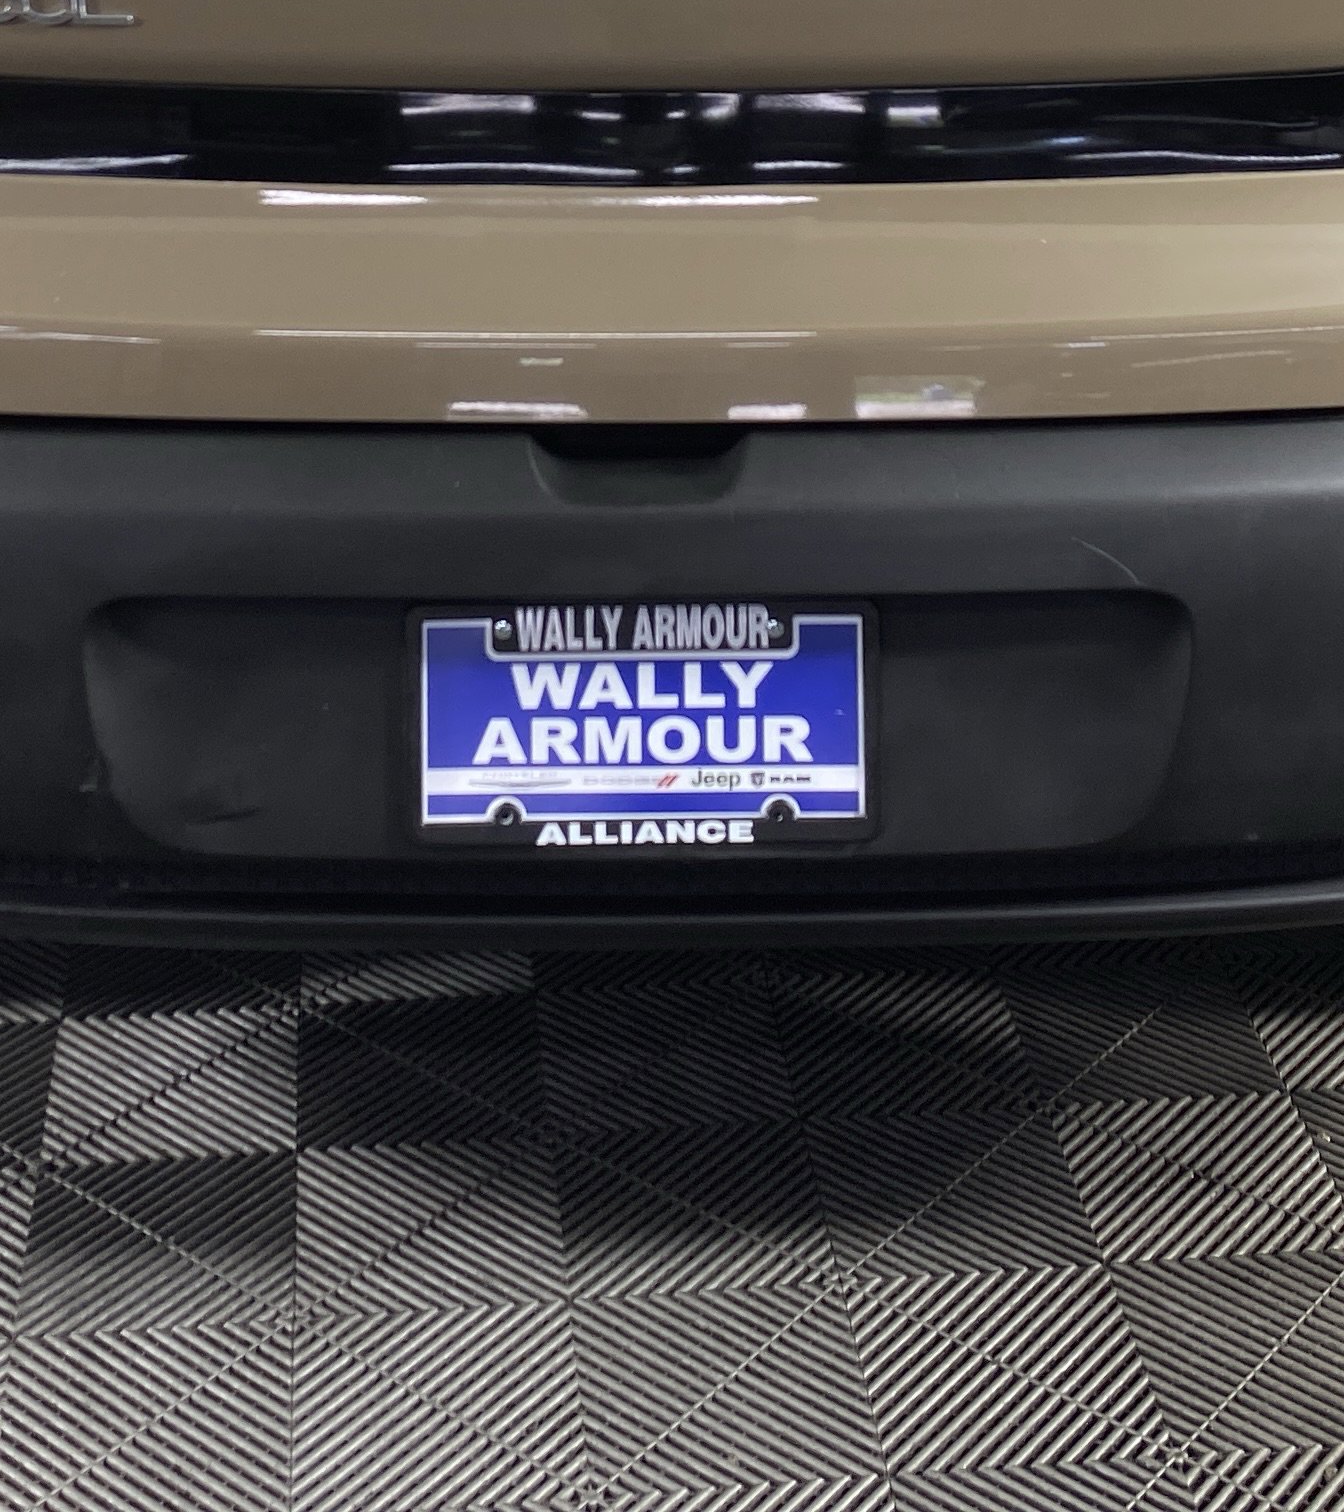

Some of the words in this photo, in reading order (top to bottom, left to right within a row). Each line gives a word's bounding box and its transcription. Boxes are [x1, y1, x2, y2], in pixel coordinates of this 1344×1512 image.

[515, 606, 623, 651] WALLY
[632, 604, 770, 650] ARMOUR
[511, 662, 774, 710] WALLY
[472, 715, 814, 764] ARMOUR
[691, 768, 741, 791] Jeep
[536, 821, 755, 846] ALLIANCE
